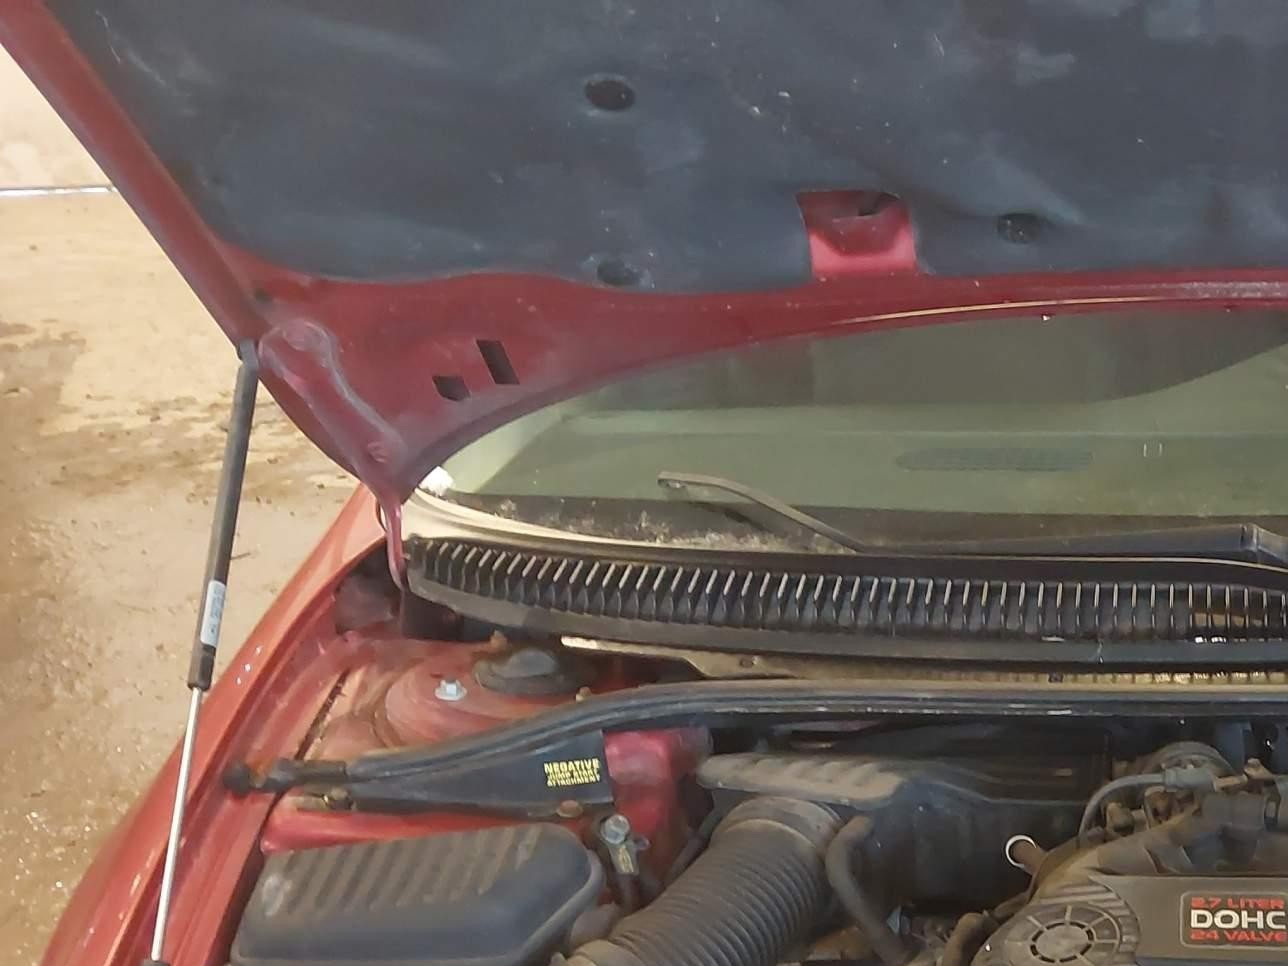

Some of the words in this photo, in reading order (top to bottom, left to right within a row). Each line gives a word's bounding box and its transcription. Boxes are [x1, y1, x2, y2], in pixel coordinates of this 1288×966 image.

[543, 757, 600, 774] NEGATIVE
[1189, 909, 1287, 930] DOHC
[1224, 930, 1288, 943] VALVE
